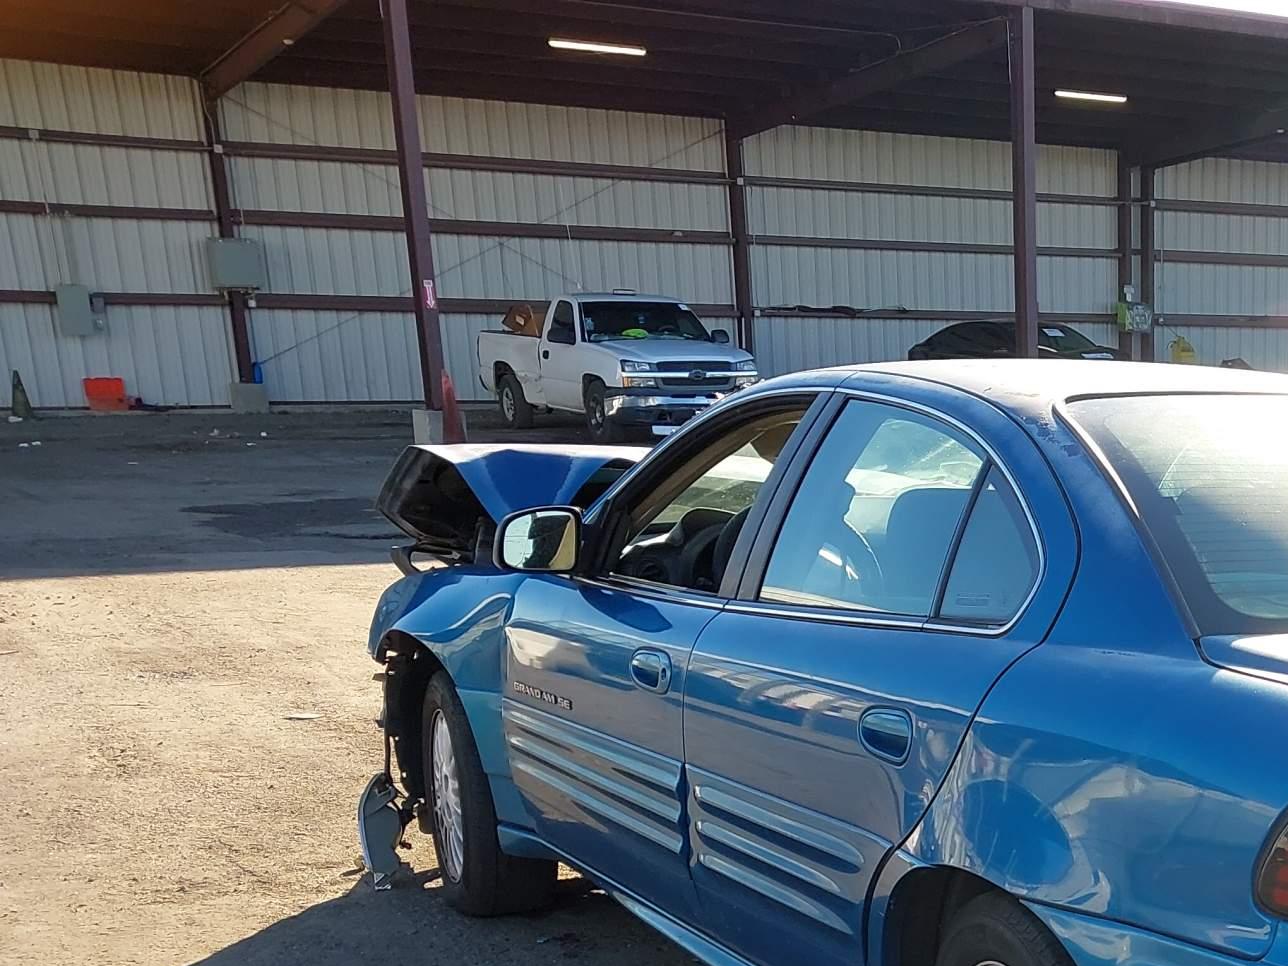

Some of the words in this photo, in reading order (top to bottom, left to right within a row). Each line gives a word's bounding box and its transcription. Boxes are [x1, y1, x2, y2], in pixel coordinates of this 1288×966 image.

[513, 681, 541, 697] GRAND
[541, 691, 556, 704] AM
[557, 697, 571, 709] SE
